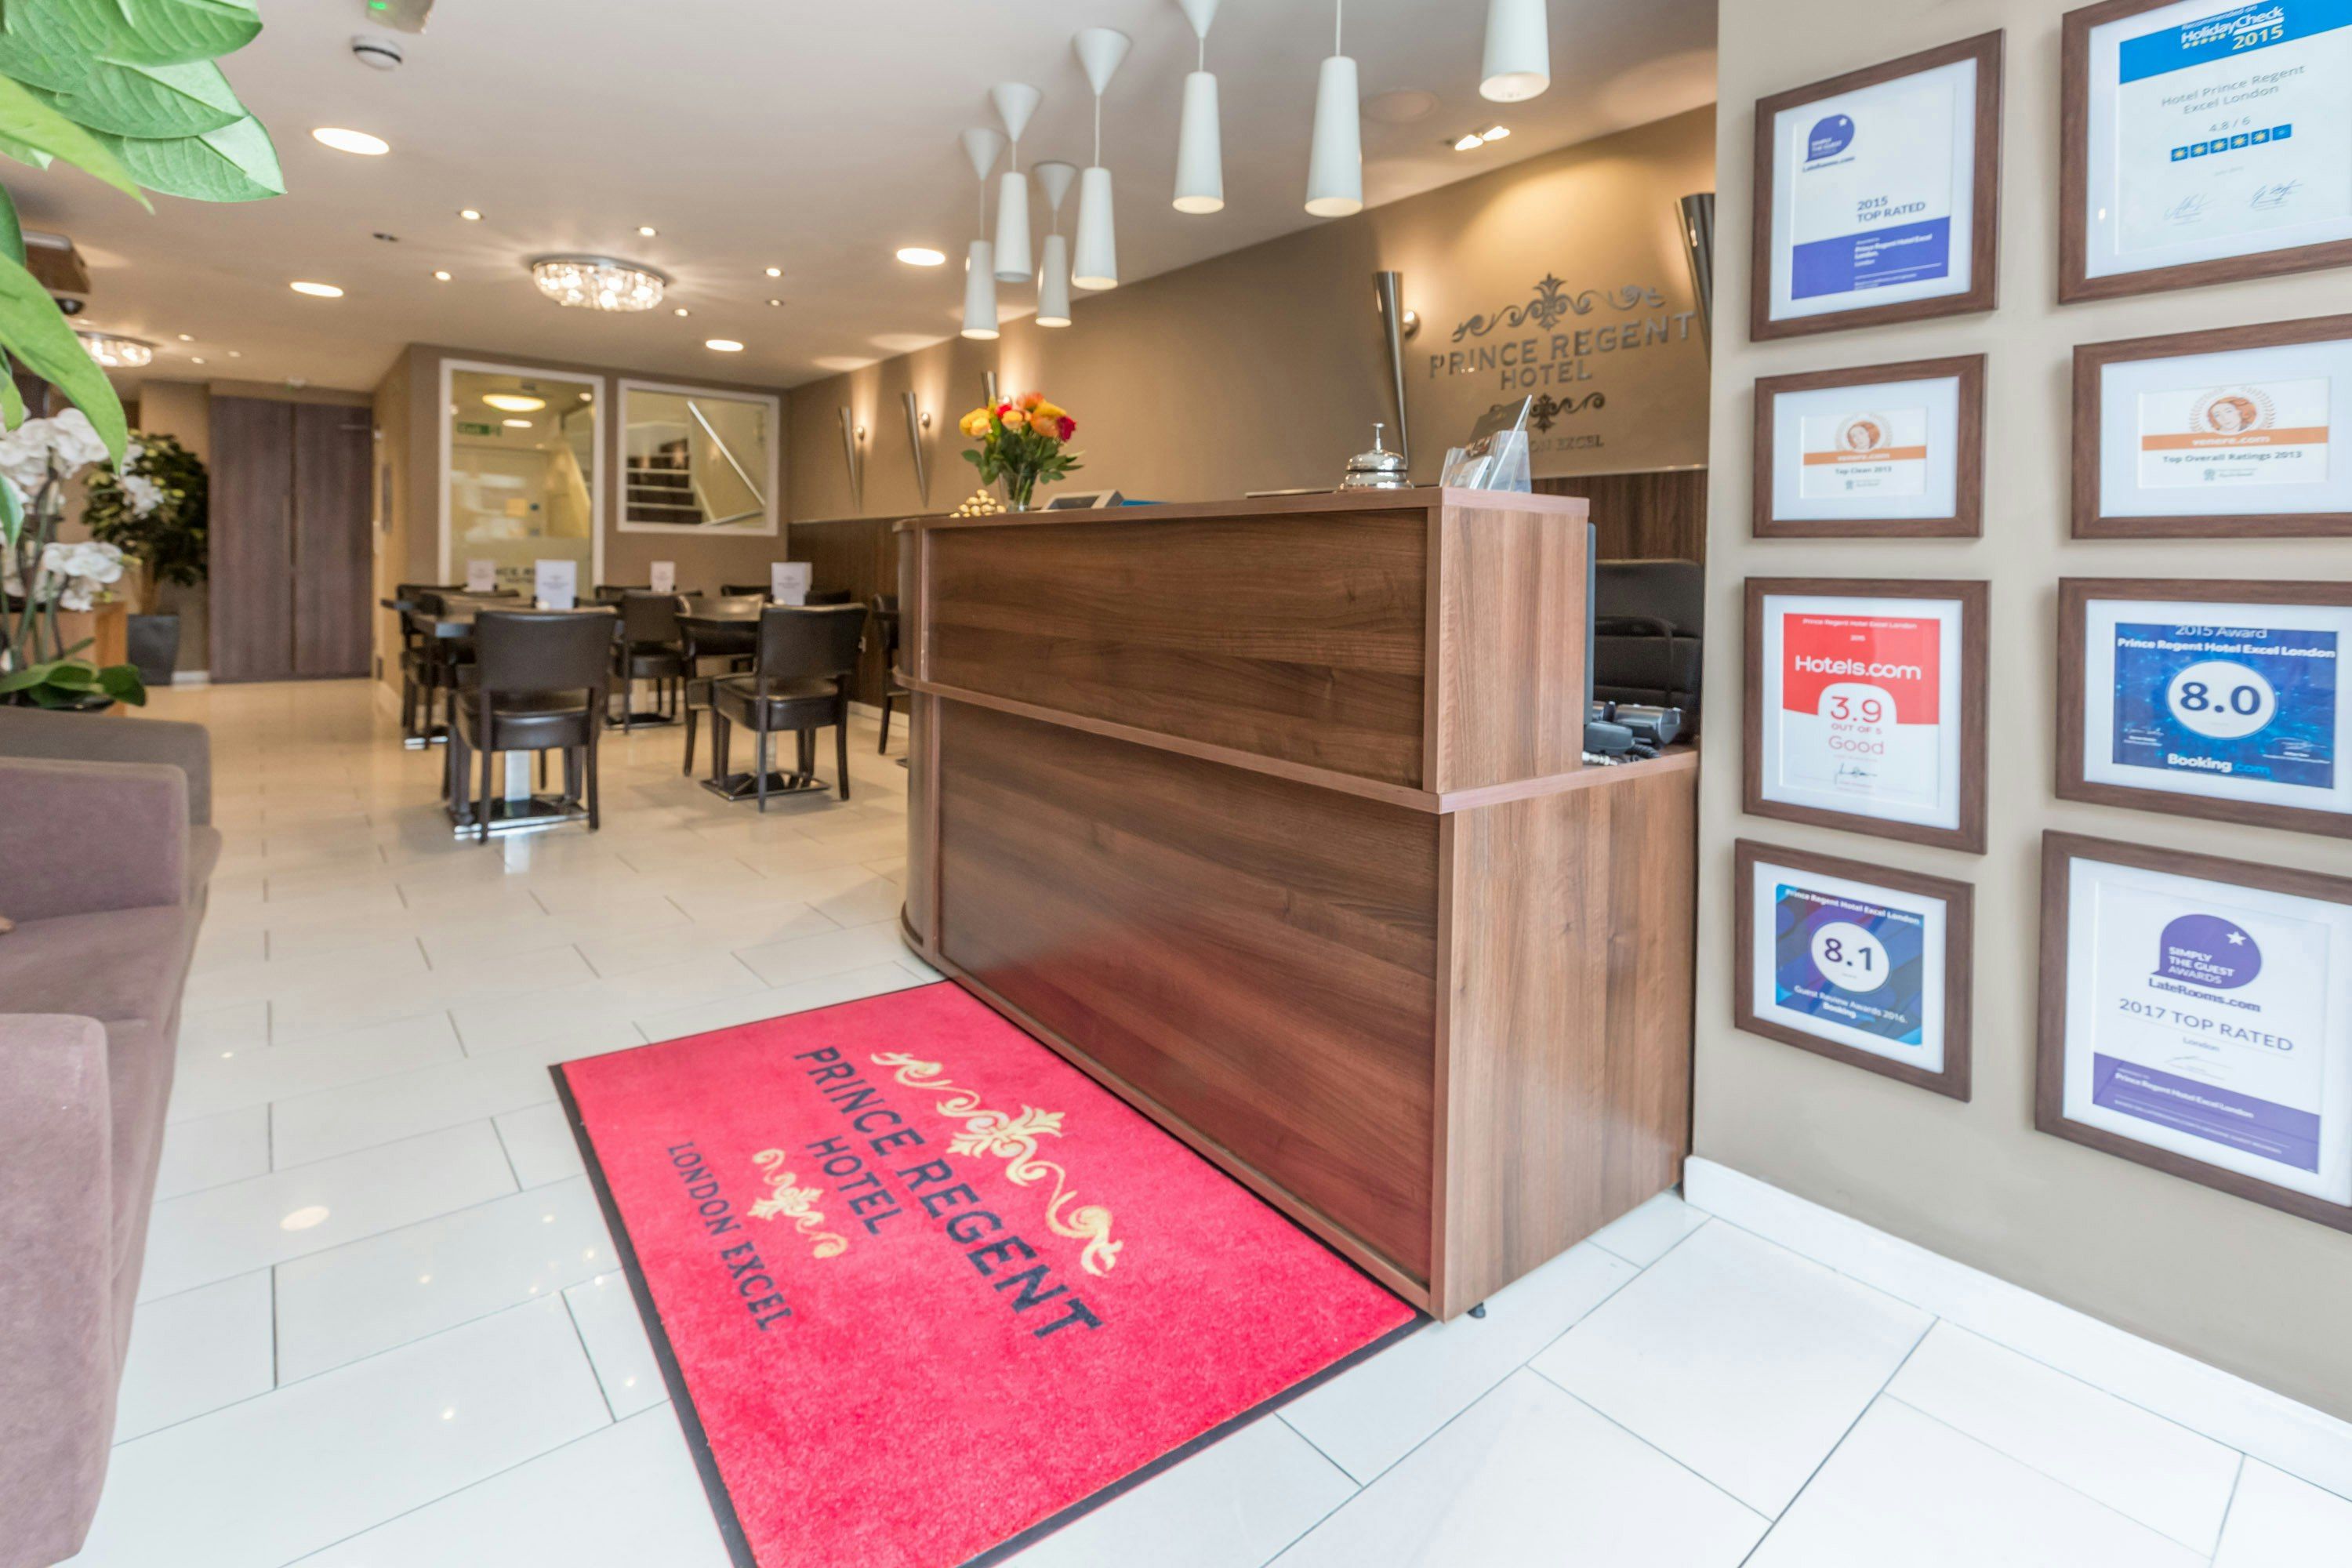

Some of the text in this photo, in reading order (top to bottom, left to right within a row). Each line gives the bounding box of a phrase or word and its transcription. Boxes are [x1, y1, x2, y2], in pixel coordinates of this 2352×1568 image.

[2181, 6, 2284, 43] HolidayCheck
[2232, 24, 2284, 50] 2015
[2161, 65, 2306, 107] Hotel Prince Regent
[2183, 85, 2279, 114] Excel London
[1857, 196, 1888, 211] 2015
[1857, 201, 1926, 223] TOP RATED
[1429, 311, 1696, 379] PRINCE REGENT
[1501, 359, 1592, 390] HOTEL
[2185, 453, 2225, 462] Overall
[2228, 452, 2271, 462] Ratings
[2175, 625, 2267, 639] 2015 Award
[2118, 637, 2336, 659] Prince Regent Hotel Excel London
[1795, 655, 1922, 680] Hotels.com
[1831, 695, 1882, 723] 3.9
[2180, 681, 2261, 716] 8.0
[1831, 723, 1853, 731] OUT
[1828, 735, 1884, 755] Good
[2168, 753, 2270, 775] Bookingcom
[1785, 888, 1810, 900] Prince
[1810, 894, 1839, 907] Regent
[1887, 911, 1920, 924] London
[1824, 938, 1872, 971] 8.1
[2169, 946, 2212, 962] SIMPLY
[2169, 956, 2235, 977] THE GUEST
[2168, 966, 2223, 984] AWARDS
[1794, 985, 1818, 998] Guest
[1819, 992, 1849, 1007] Review
[1849, 1001, 1882, 1016] Awards
[2148, 978, 2261, 1012] LateRooms.com
[1823, 1001, 1875, 1023] Booking
[2119, 998, 2293, 1051] 2017 TOP RATED
[793, 1045, 1106, 1339] PRINCE REGENT
[805, 1135, 904, 1236] HOTEL
[667, 1142, 794, 1331] LONDON EXCEL
